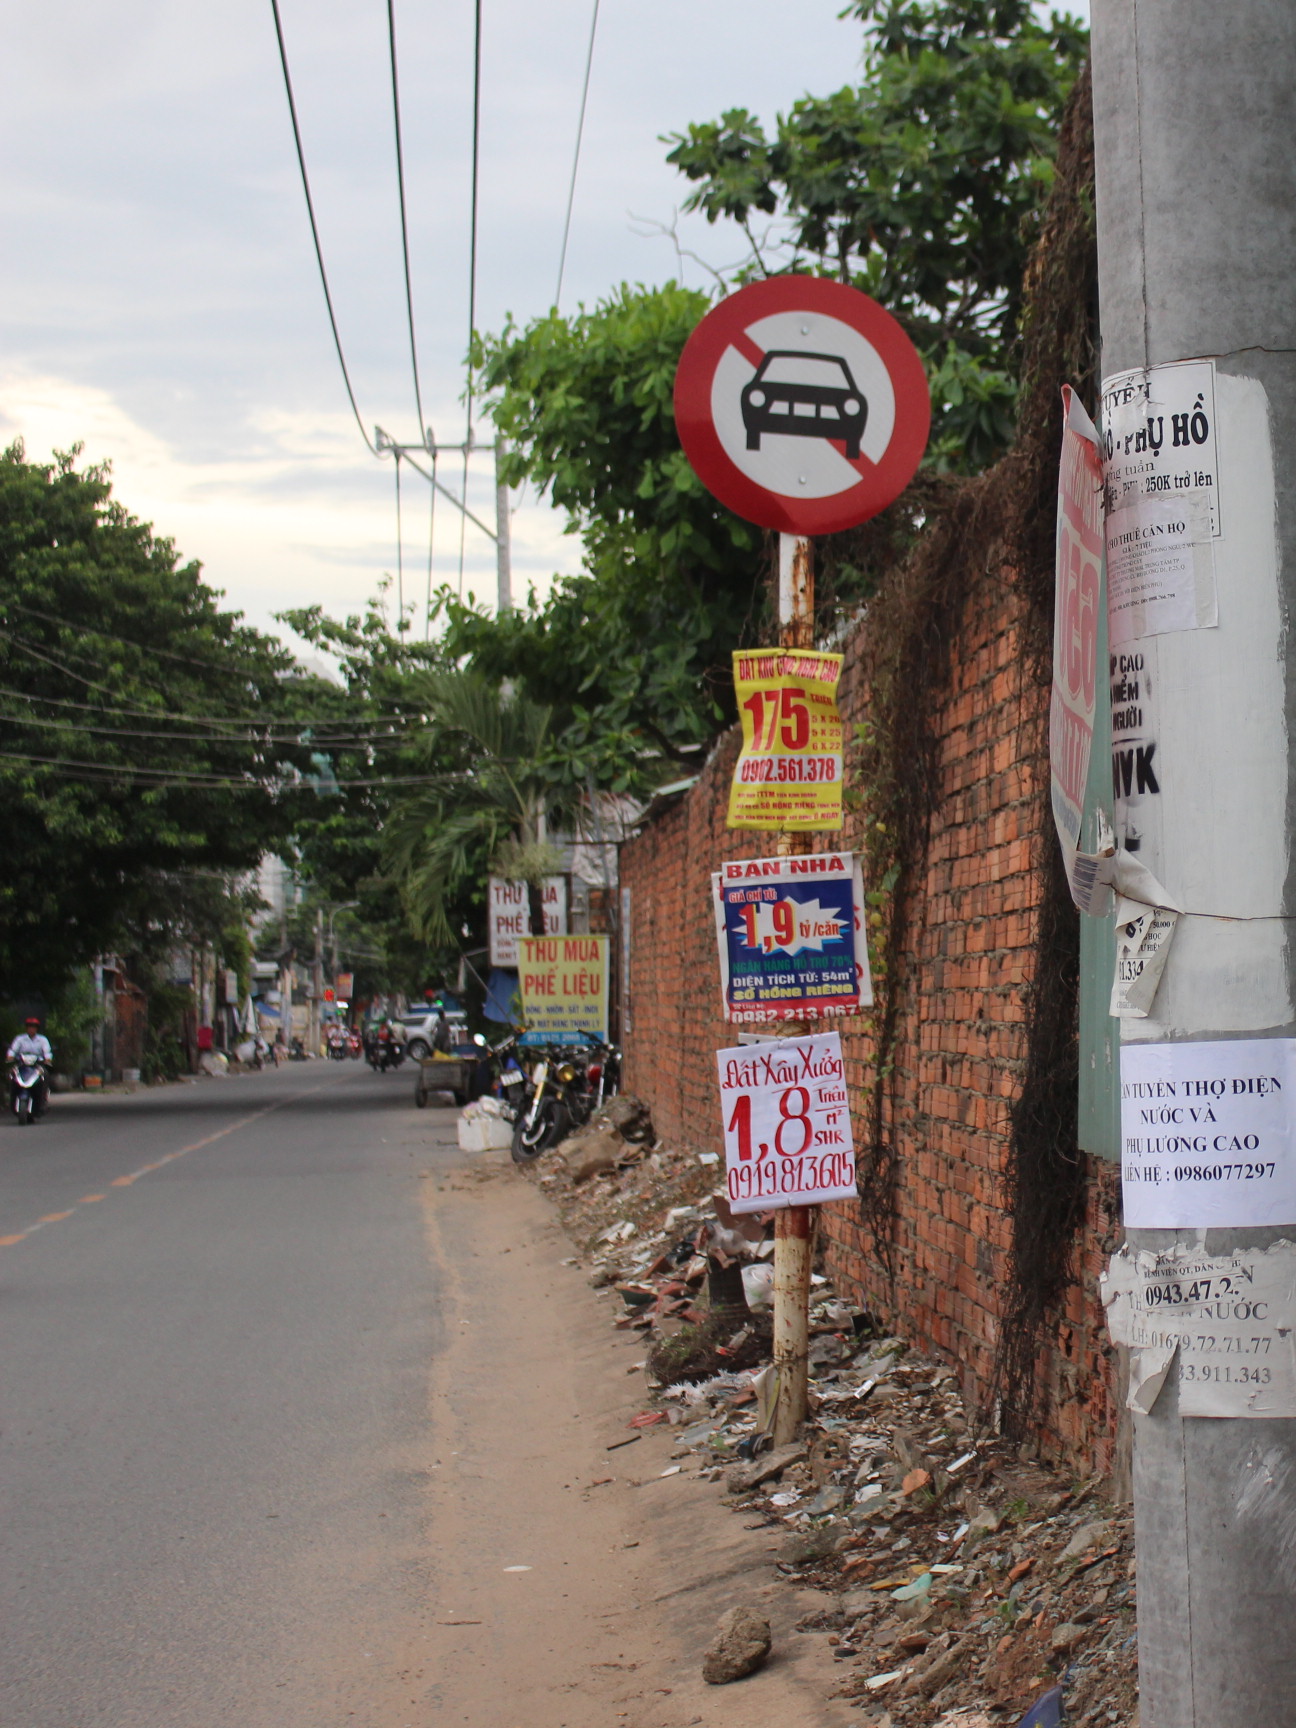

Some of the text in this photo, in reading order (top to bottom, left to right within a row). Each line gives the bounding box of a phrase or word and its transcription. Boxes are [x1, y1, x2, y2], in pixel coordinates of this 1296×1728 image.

[1172, 393, 1208, 446] HỒ
[1146, 475, 1171, 493] 250K
[1174, 471, 1190, 489] trở
[1195, 471, 1212, 487] lên
[1119, 528, 1141, 546] THUÊ
[1143, 524, 1164, 538] CĂN
[1168, 522, 1185, 534] HỘ
[1120, 654, 1144, 674] CAO
[743, 687, 810, 751] 175
[727, 856, 845, 878] BÁN NHÀ
[729, 889, 745, 903] GIÁ
[738, 901, 795, 953] 1,9
[800, 920, 810, 938] tỷ
[524, 940, 557, 962] THU
[564, 939, 599, 962] MUA
[524, 965, 600, 1000] PHẾ LIỆU
[767, 973, 795, 985] TÍCH
[722, 1059, 760, 1089] Đất
[760, 1053, 799, 1094] Xây
[1182, 1078, 1226, 1100] THỢ
[1232, 1075, 1282, 1097] ĐIỆN
[728, 1086, 813, 1164] 1,8
[1140, 1102, 1217, 1125] NƯỚC VÀ
[814, 1130, 845, 1146] SHR
[1126, 1134, 1260, 1157] PHỤ LƯƠNG CAO
[1144, 1164, 1162, 1186] HỆ
[1175, 1162, 1276, 1182] 0986077297
[1200, 1297, 1268, 1320] NƯỚC
